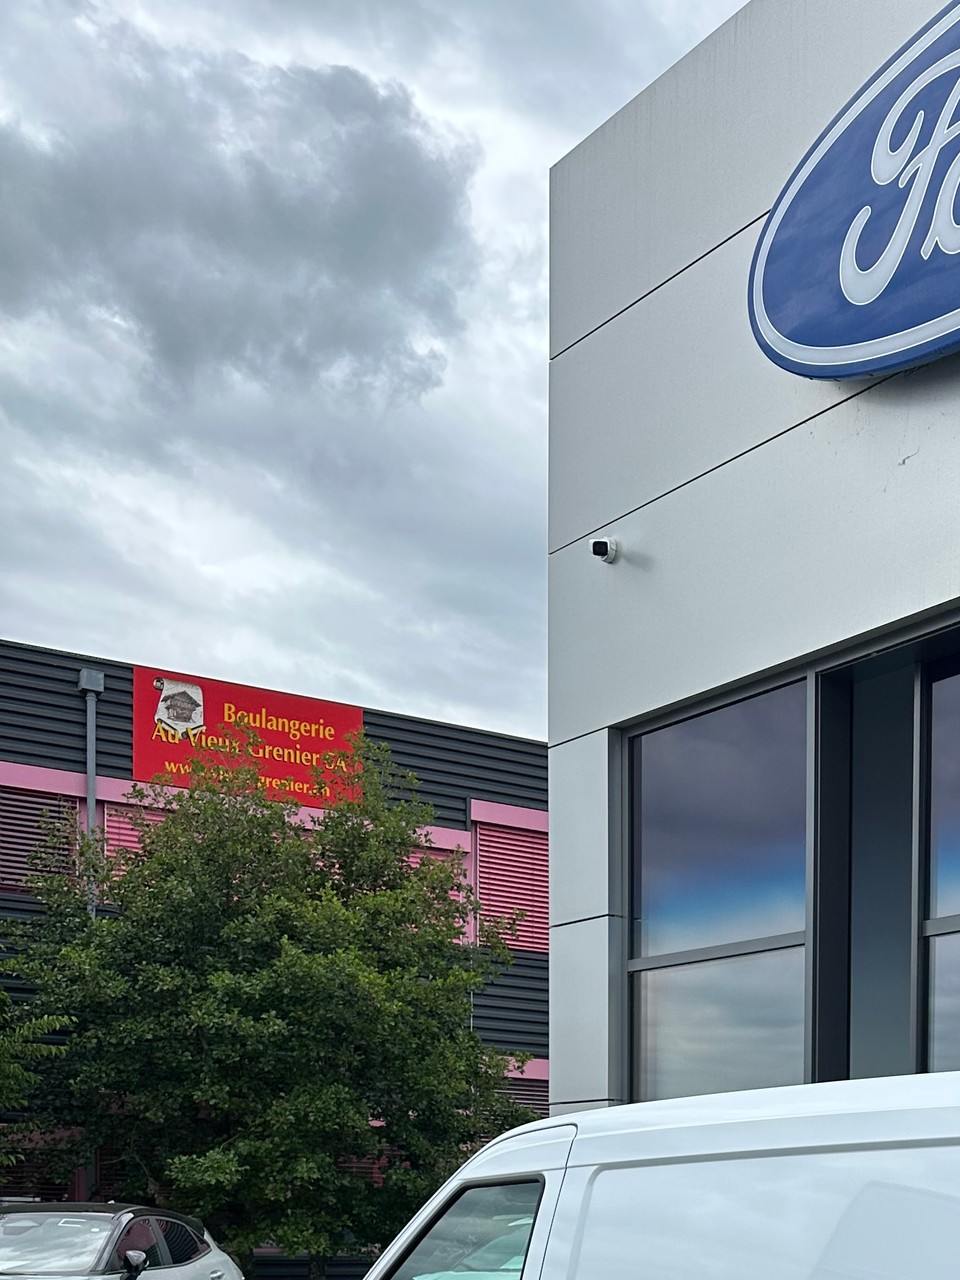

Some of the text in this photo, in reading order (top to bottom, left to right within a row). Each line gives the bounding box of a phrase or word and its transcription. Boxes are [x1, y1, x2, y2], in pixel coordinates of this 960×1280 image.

[223, 702, 335, 741] Boulangerie
[151, 721, 180, 744] Au
[186, 726, 241, 754] Vieux
[248, 738, 320, 767] Grenier
